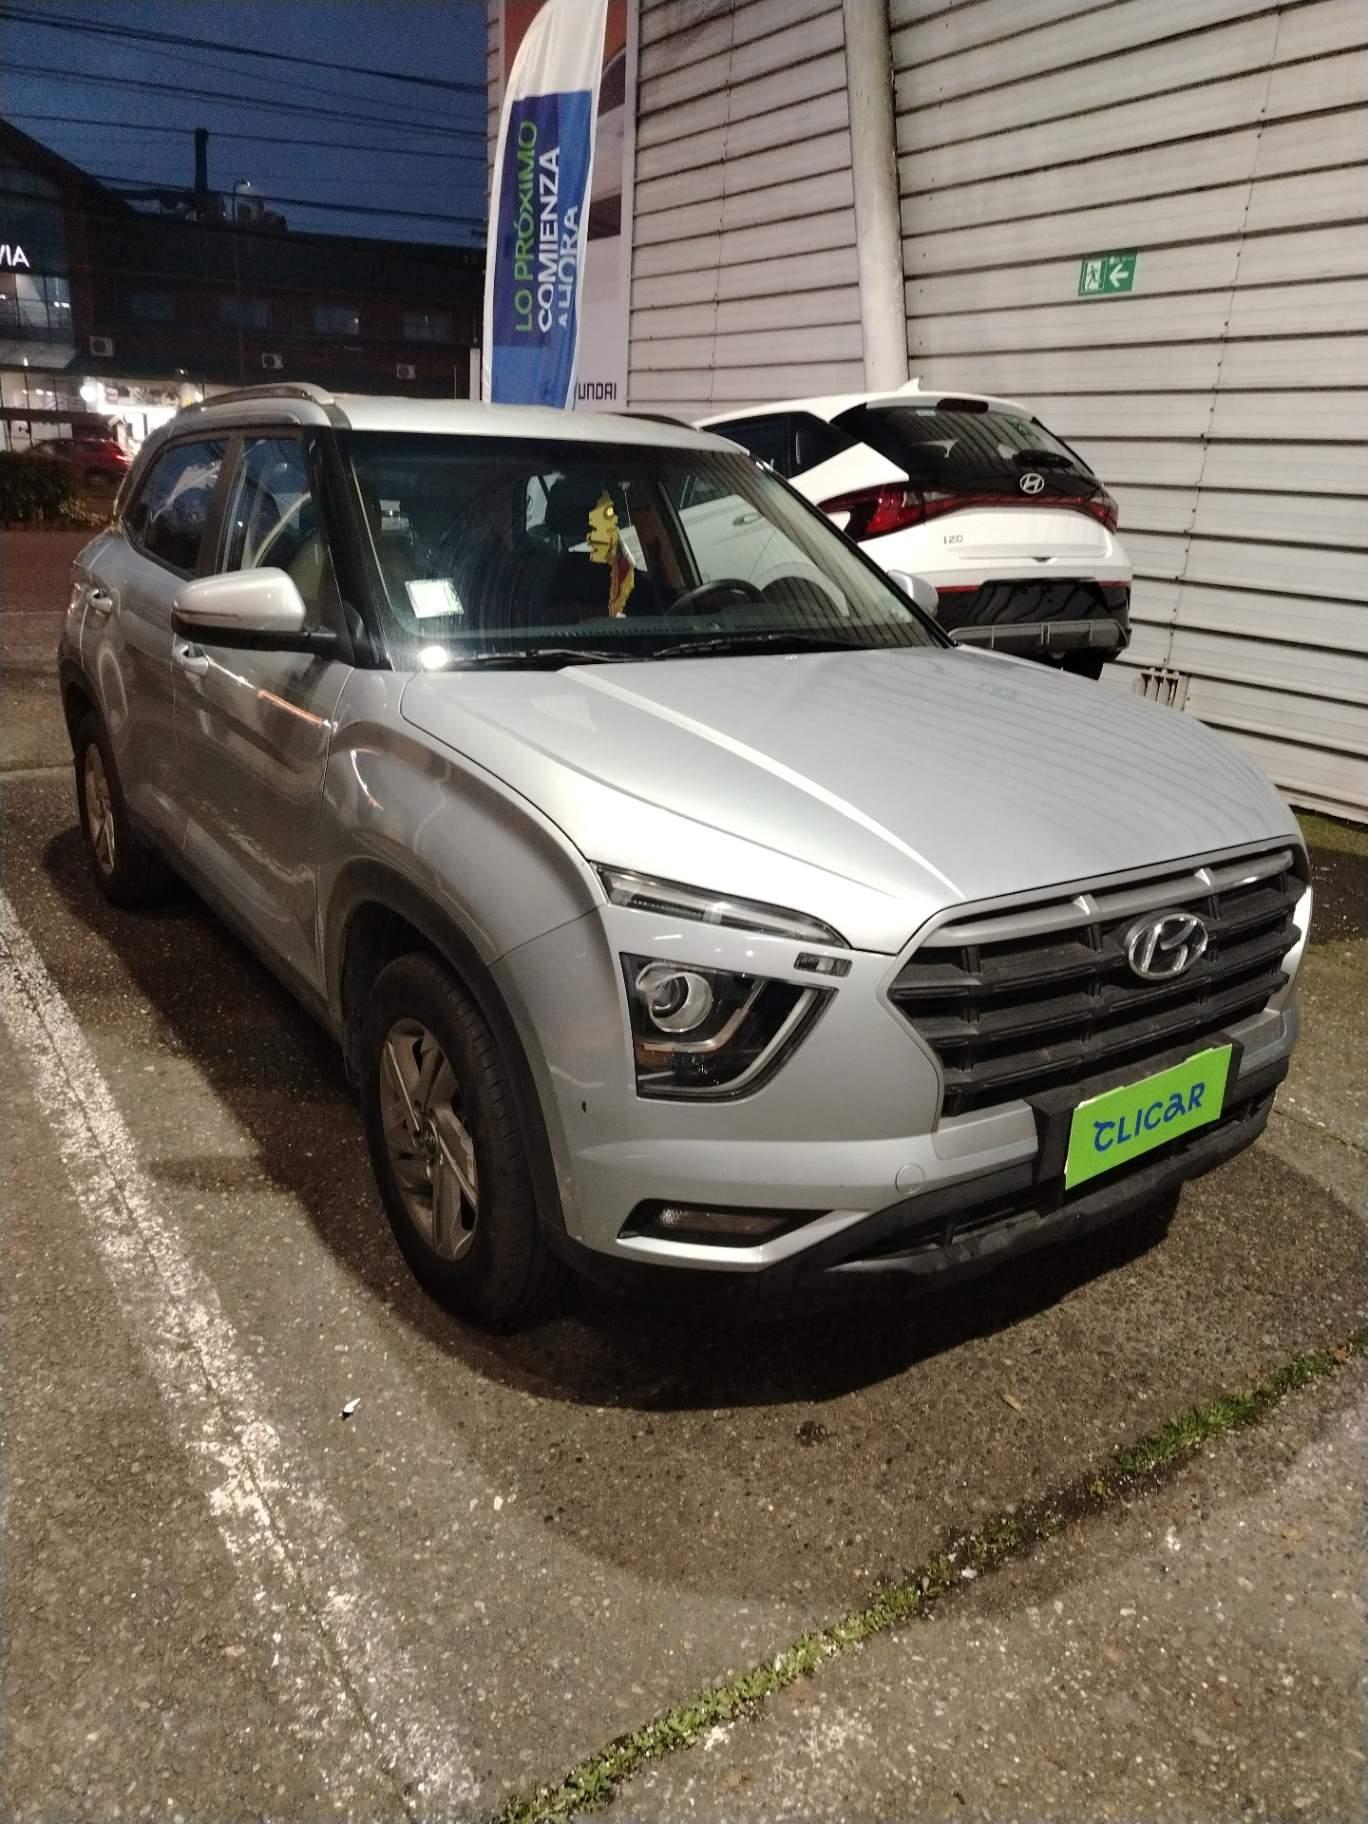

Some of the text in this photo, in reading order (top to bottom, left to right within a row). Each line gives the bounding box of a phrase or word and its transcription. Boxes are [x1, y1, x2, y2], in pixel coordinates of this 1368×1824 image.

[513, 120, 538, 332] LO PRÓXIMO
[537, 146, 560, 333] COMIENZA
[578, 382, 616, 400] UNDAI
